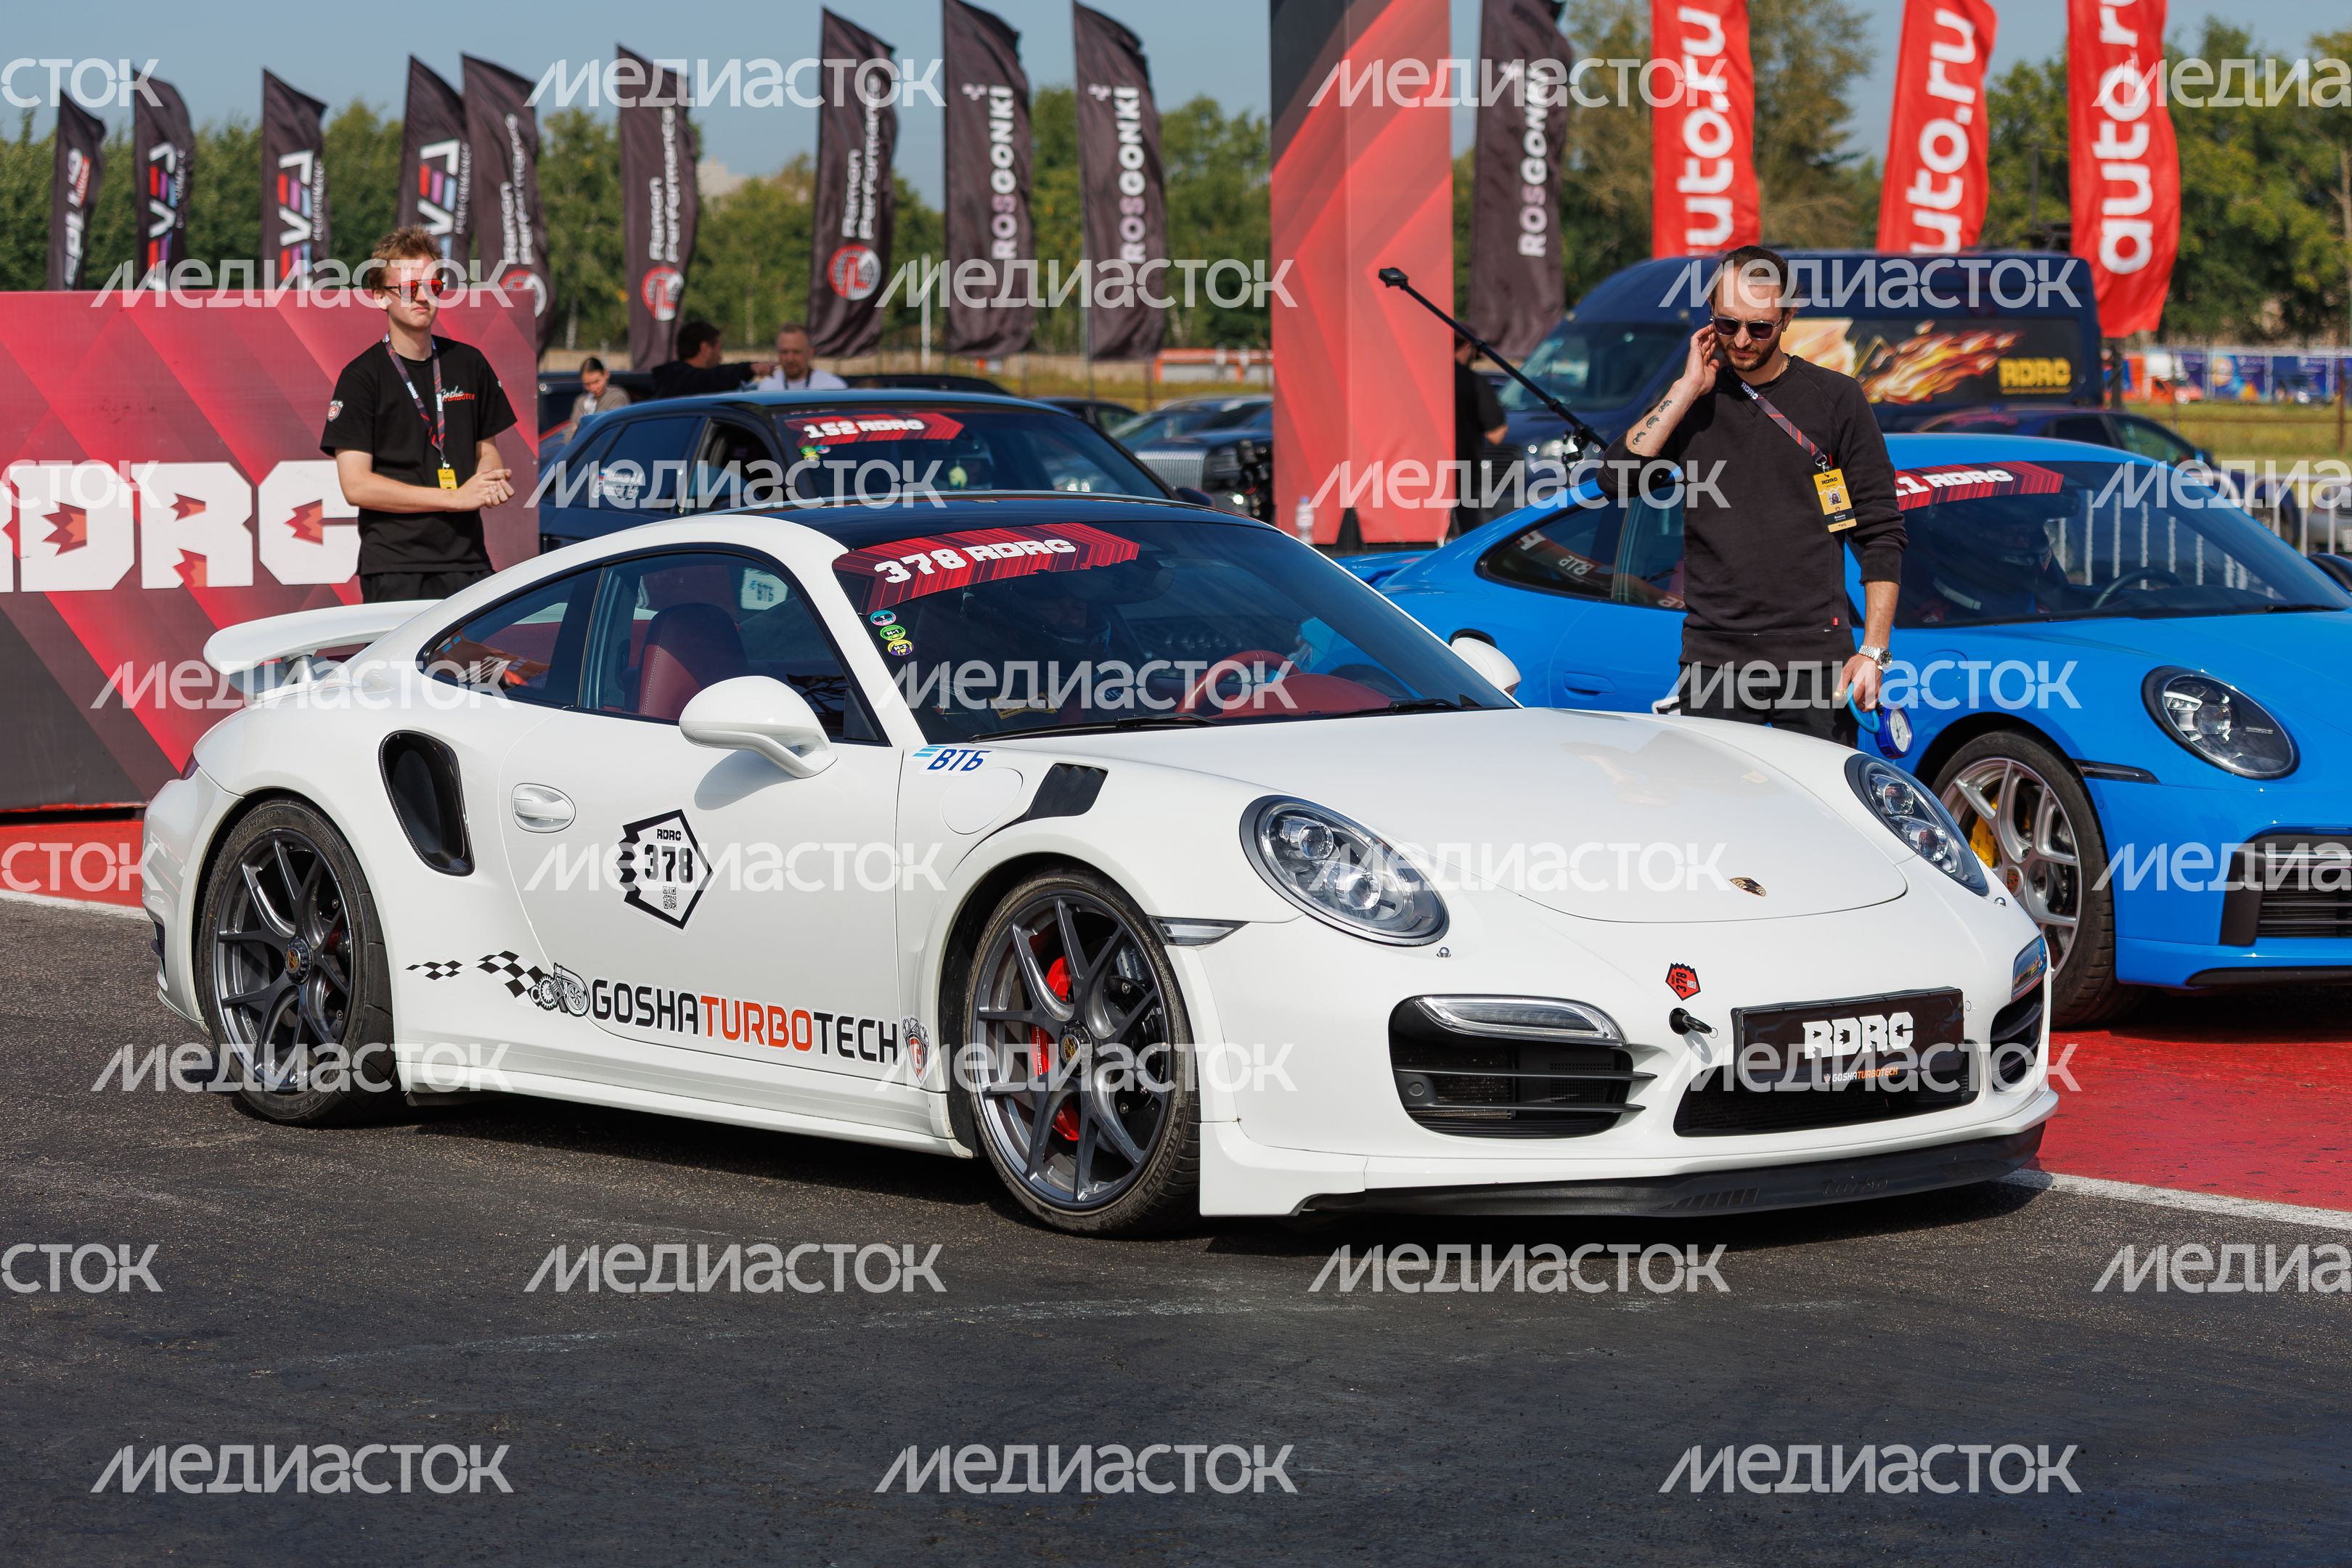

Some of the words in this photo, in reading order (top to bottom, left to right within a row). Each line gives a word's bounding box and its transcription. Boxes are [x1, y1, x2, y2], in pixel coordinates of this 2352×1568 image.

[1675, 7, 1736, 256] uto.ru
[1905, 7, 1976, 253] uto.ru
[2092, 0, 2154, 274] auto.r
[989, 85, 1017, 261] ROSGONKI
[1112, 86, 1147, 264] ROSGONKI
[1998, 357, 2071, 387] RDRC
[803, 420, 859, 439] 152
[1922, 469, 2014, 488] RDRC
[874, 547, 968, 584] 378
[961, 539, 1077, 563] RDRC
[927, 748, 991, 772] ВТБ
[656, 829, 682, 841] RDRC
[644, 844, 693, 884] 378
[1676, 971, 1687, 993] 378
[592, 979, 898, 1067] GOSHATURBOTECH
[1802, 1011, 1914, 1060] RDRC
[1832, 1066, 1898, 1082] GOSHATURBOTECH
